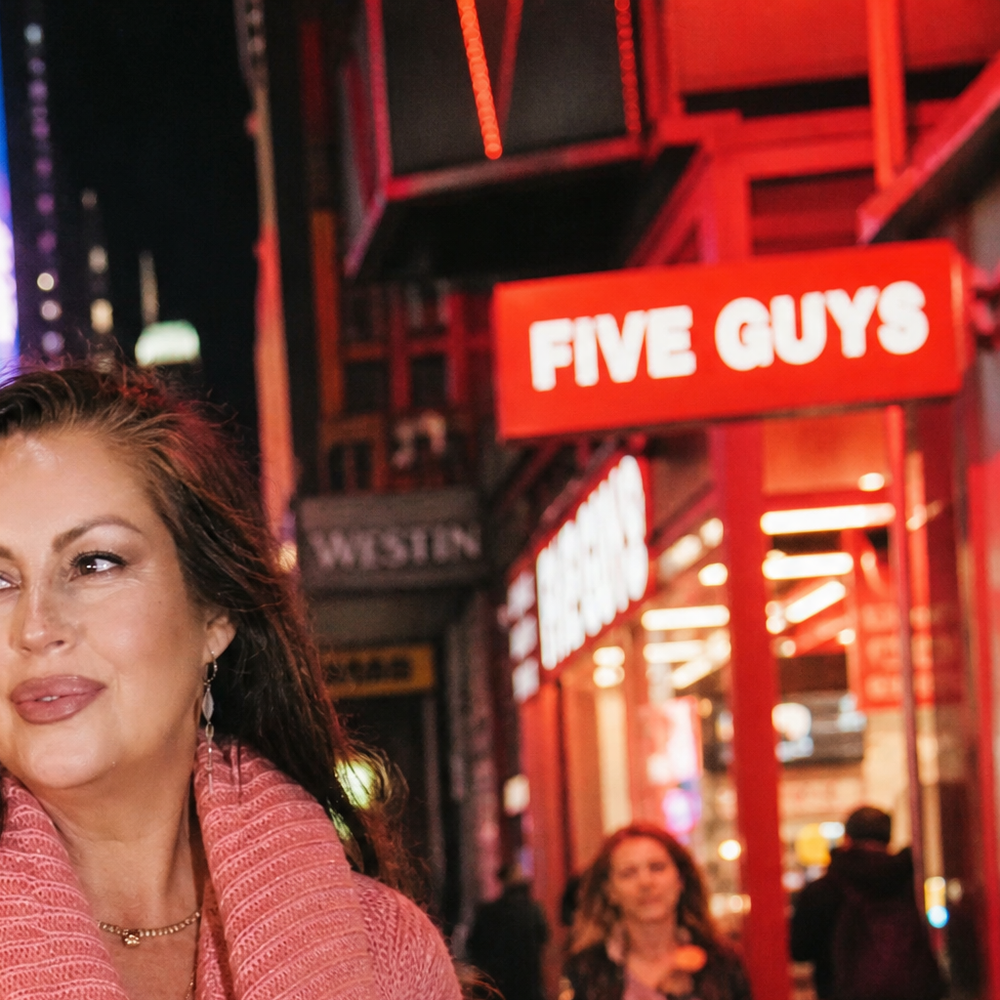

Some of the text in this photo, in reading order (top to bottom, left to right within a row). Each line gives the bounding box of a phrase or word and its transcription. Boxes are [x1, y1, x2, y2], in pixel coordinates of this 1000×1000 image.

[528, 280, 930, 392] FIVE GUYS
[308, 522, 481, 570] WESTIN
